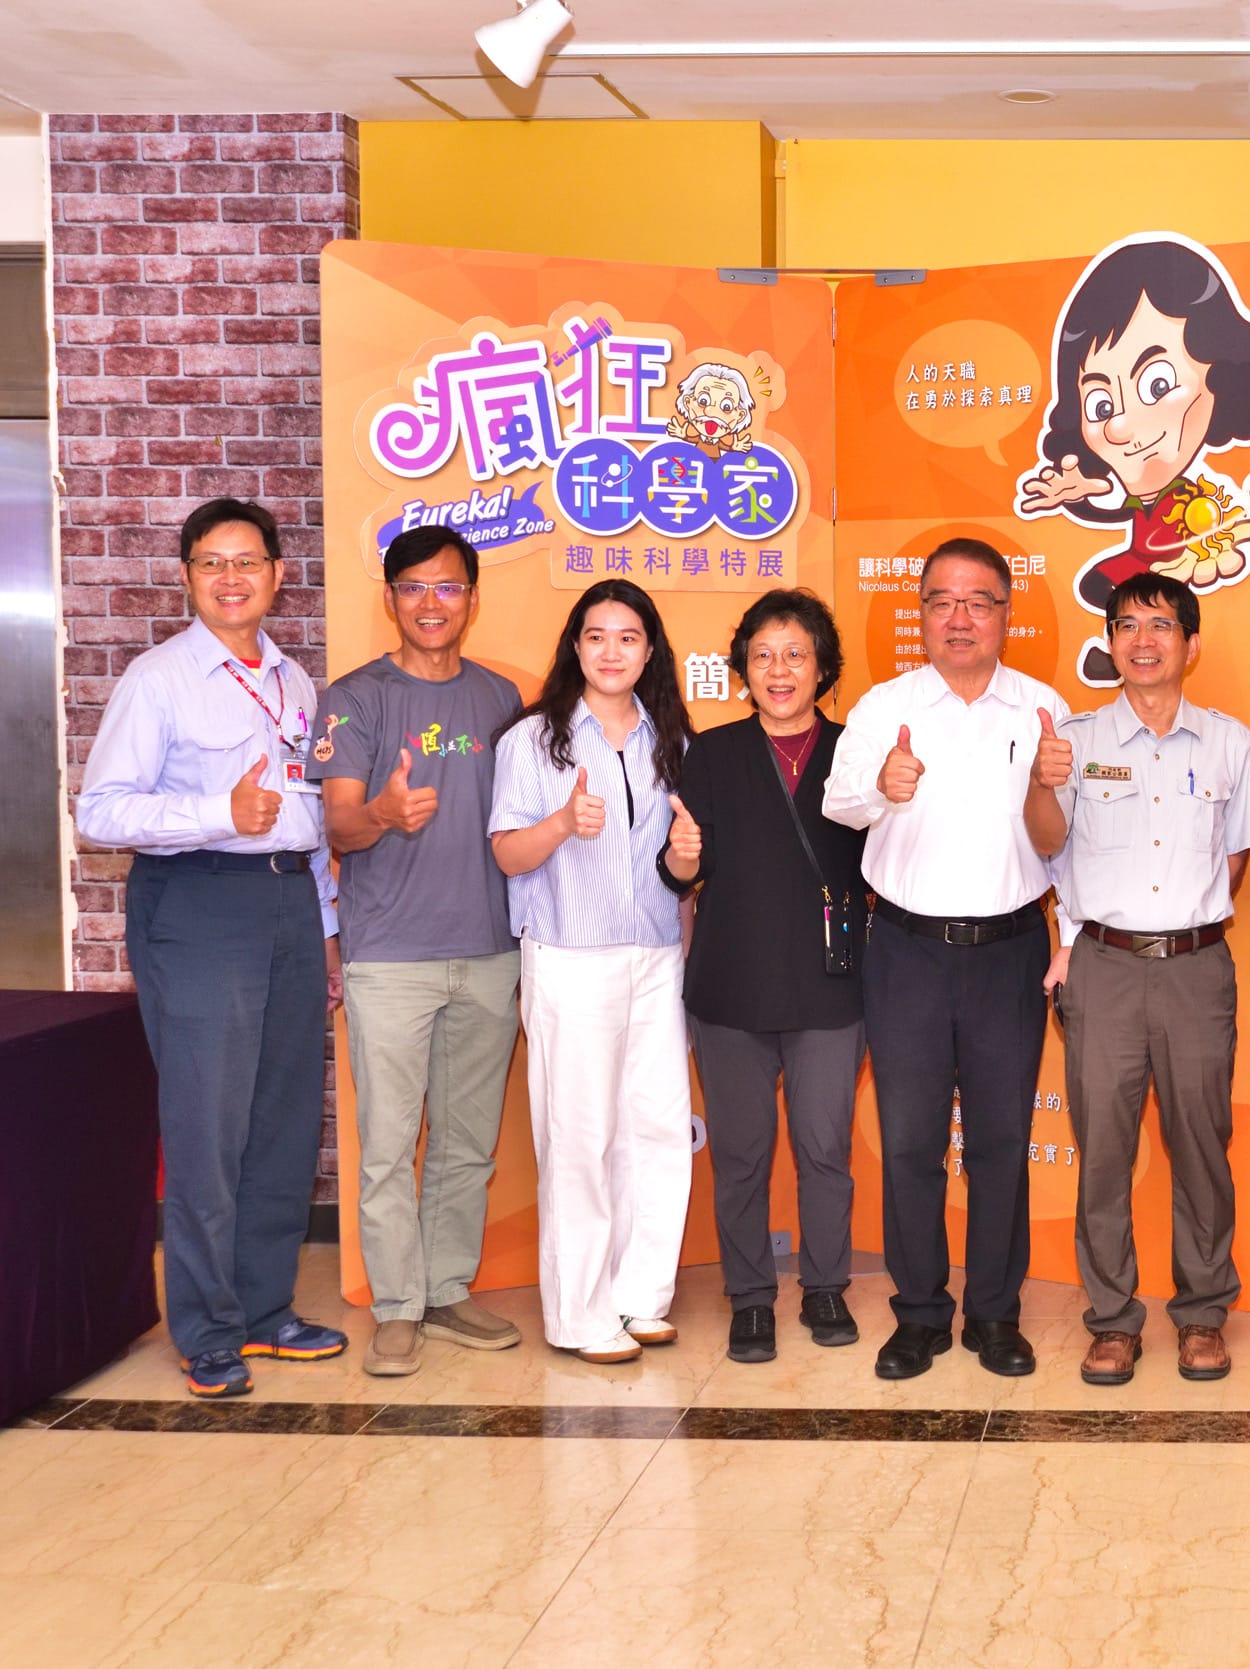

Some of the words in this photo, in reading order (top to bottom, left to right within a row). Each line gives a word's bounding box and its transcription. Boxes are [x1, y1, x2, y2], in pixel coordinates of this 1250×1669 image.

[905, 361, 976, 383] 人的天職
[370, 318, 672, 481] 瘋狂
[905, 385, 1033, 411] 在勇於探索真理
[566, 449, 785, 529] 科學家
[401, 486, 513, 533] Eureka!
[462, 524, 510, 545] ience
[513, 517, 555, 537] Zone
[564, 544, 785, 578] 趣味科學特展
[858, 557, 929, 578] 讓科學破
[1002, 555, 1046, 576] 白尼
[858, 580, 899, 593] Nicolaus
[895, 626, 923, 638] 同時兼
[683, 652, 750, 703] 簡
